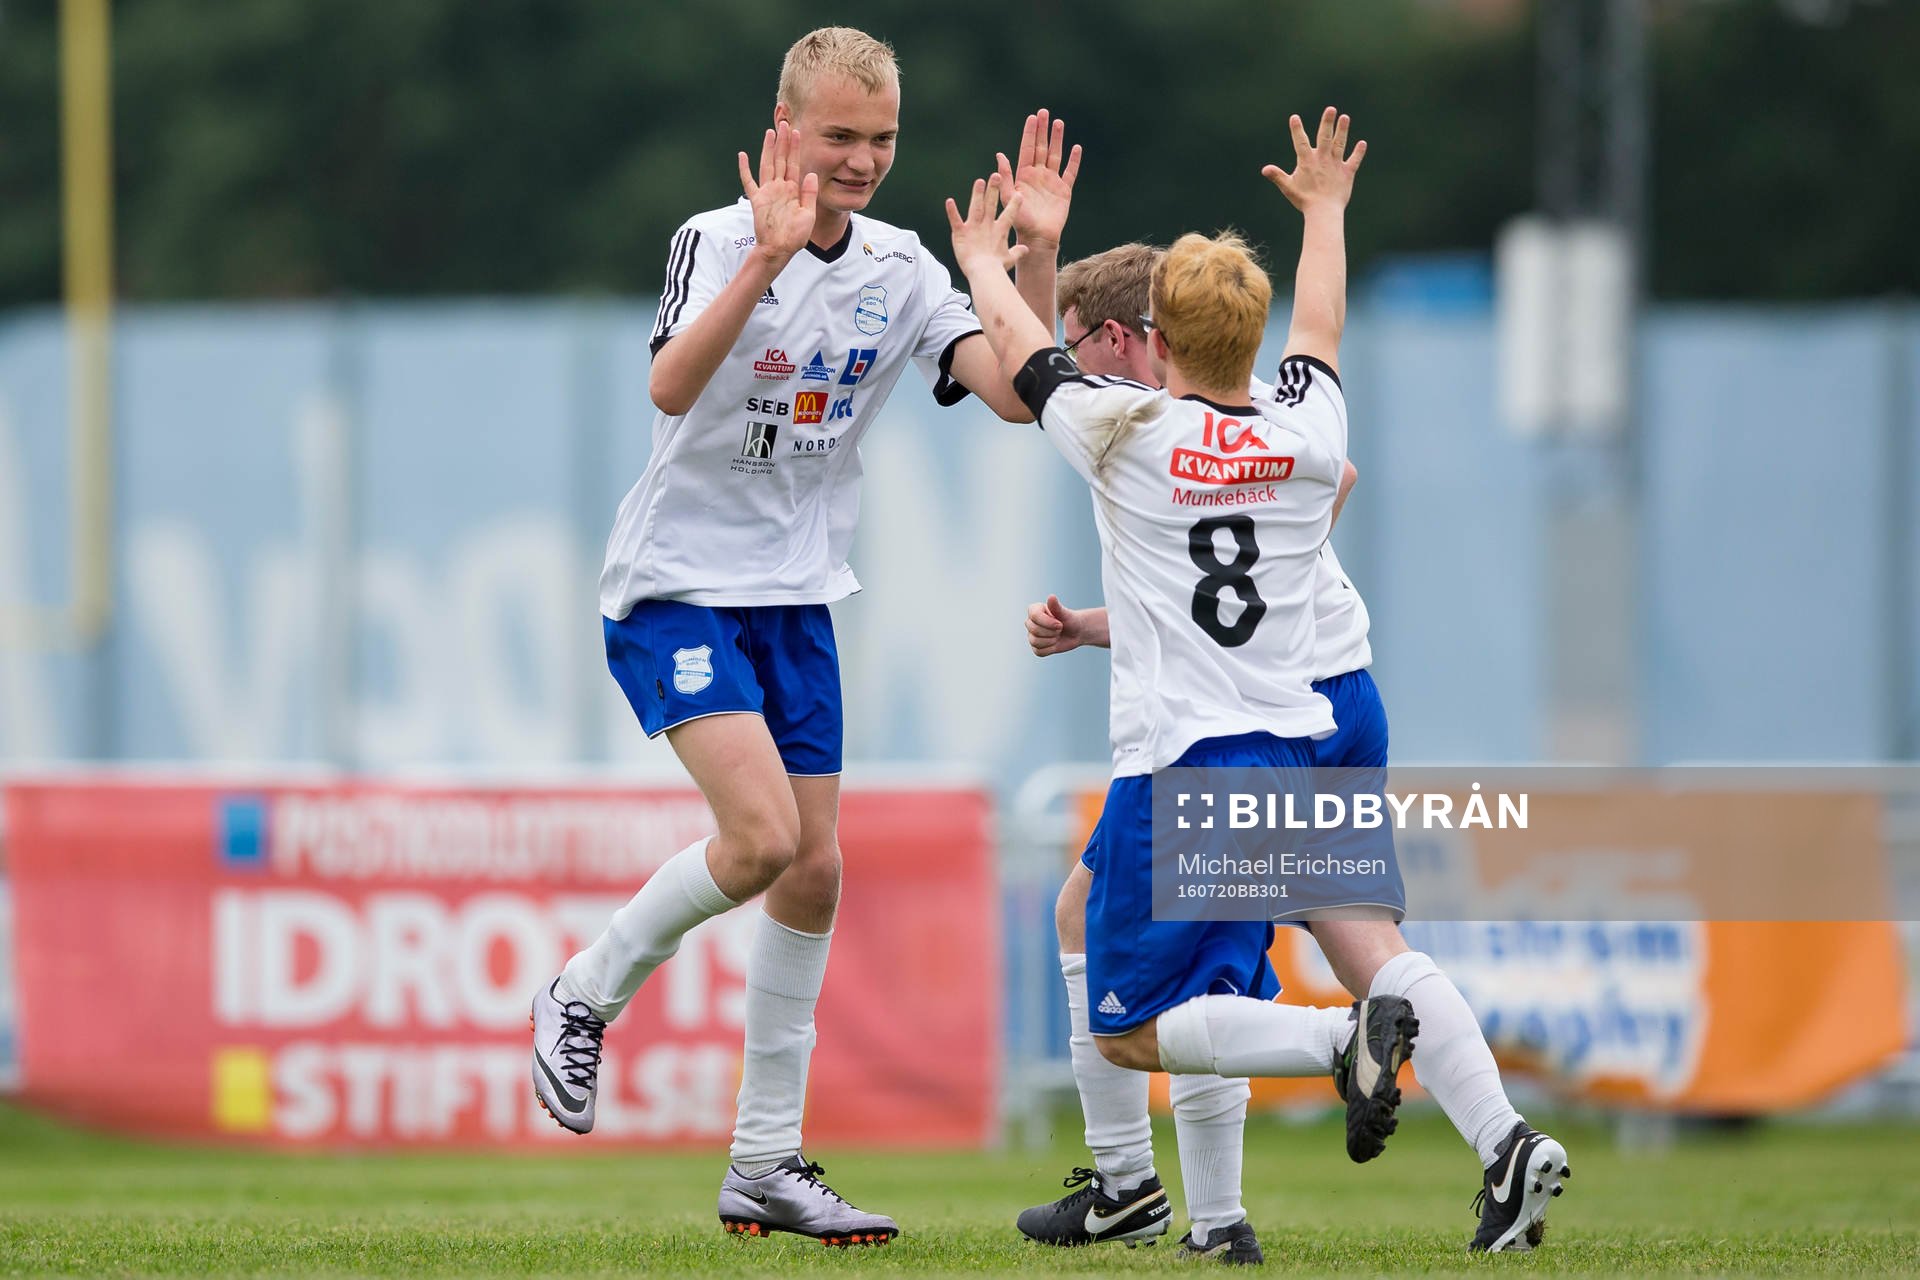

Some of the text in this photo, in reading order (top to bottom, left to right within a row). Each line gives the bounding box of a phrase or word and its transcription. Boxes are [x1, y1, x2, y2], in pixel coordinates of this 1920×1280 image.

[765, 349, 788, 363] ICA
[756, 362, 795, 373] KVANTUM
[1202, 411, 1270, 454] ICA
[793, 437, 840, 452] NORD
[730, 466, 773, 475] HOLDING
[732, 458, 776, 468] HANSSON
[1177, 453, 1289, 481] KVANTUM
[1172, 484, 1278, 507] Munkebäck
[1188, 515, 1268, 648] 8
